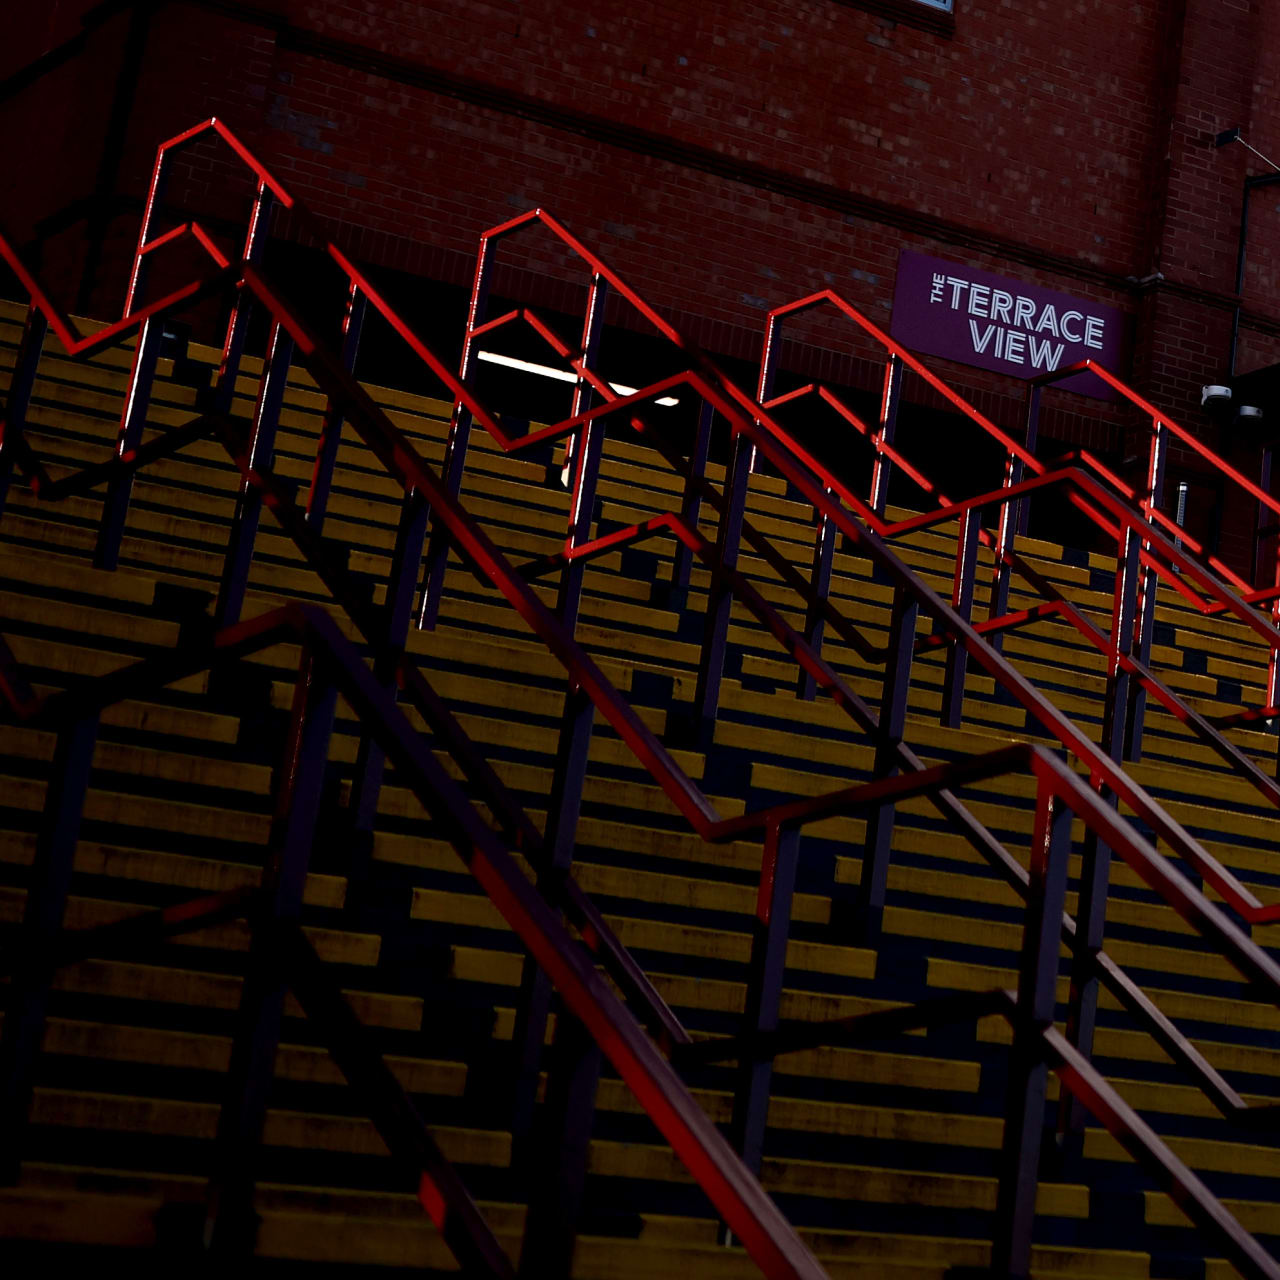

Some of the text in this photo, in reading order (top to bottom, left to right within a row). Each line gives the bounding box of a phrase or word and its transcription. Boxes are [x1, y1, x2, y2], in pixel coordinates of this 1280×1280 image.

[930, 272, 945, 303] THE
[946, 276, 1105, 350] TERRACE
[968, 319, 1065, 372] VIEW
